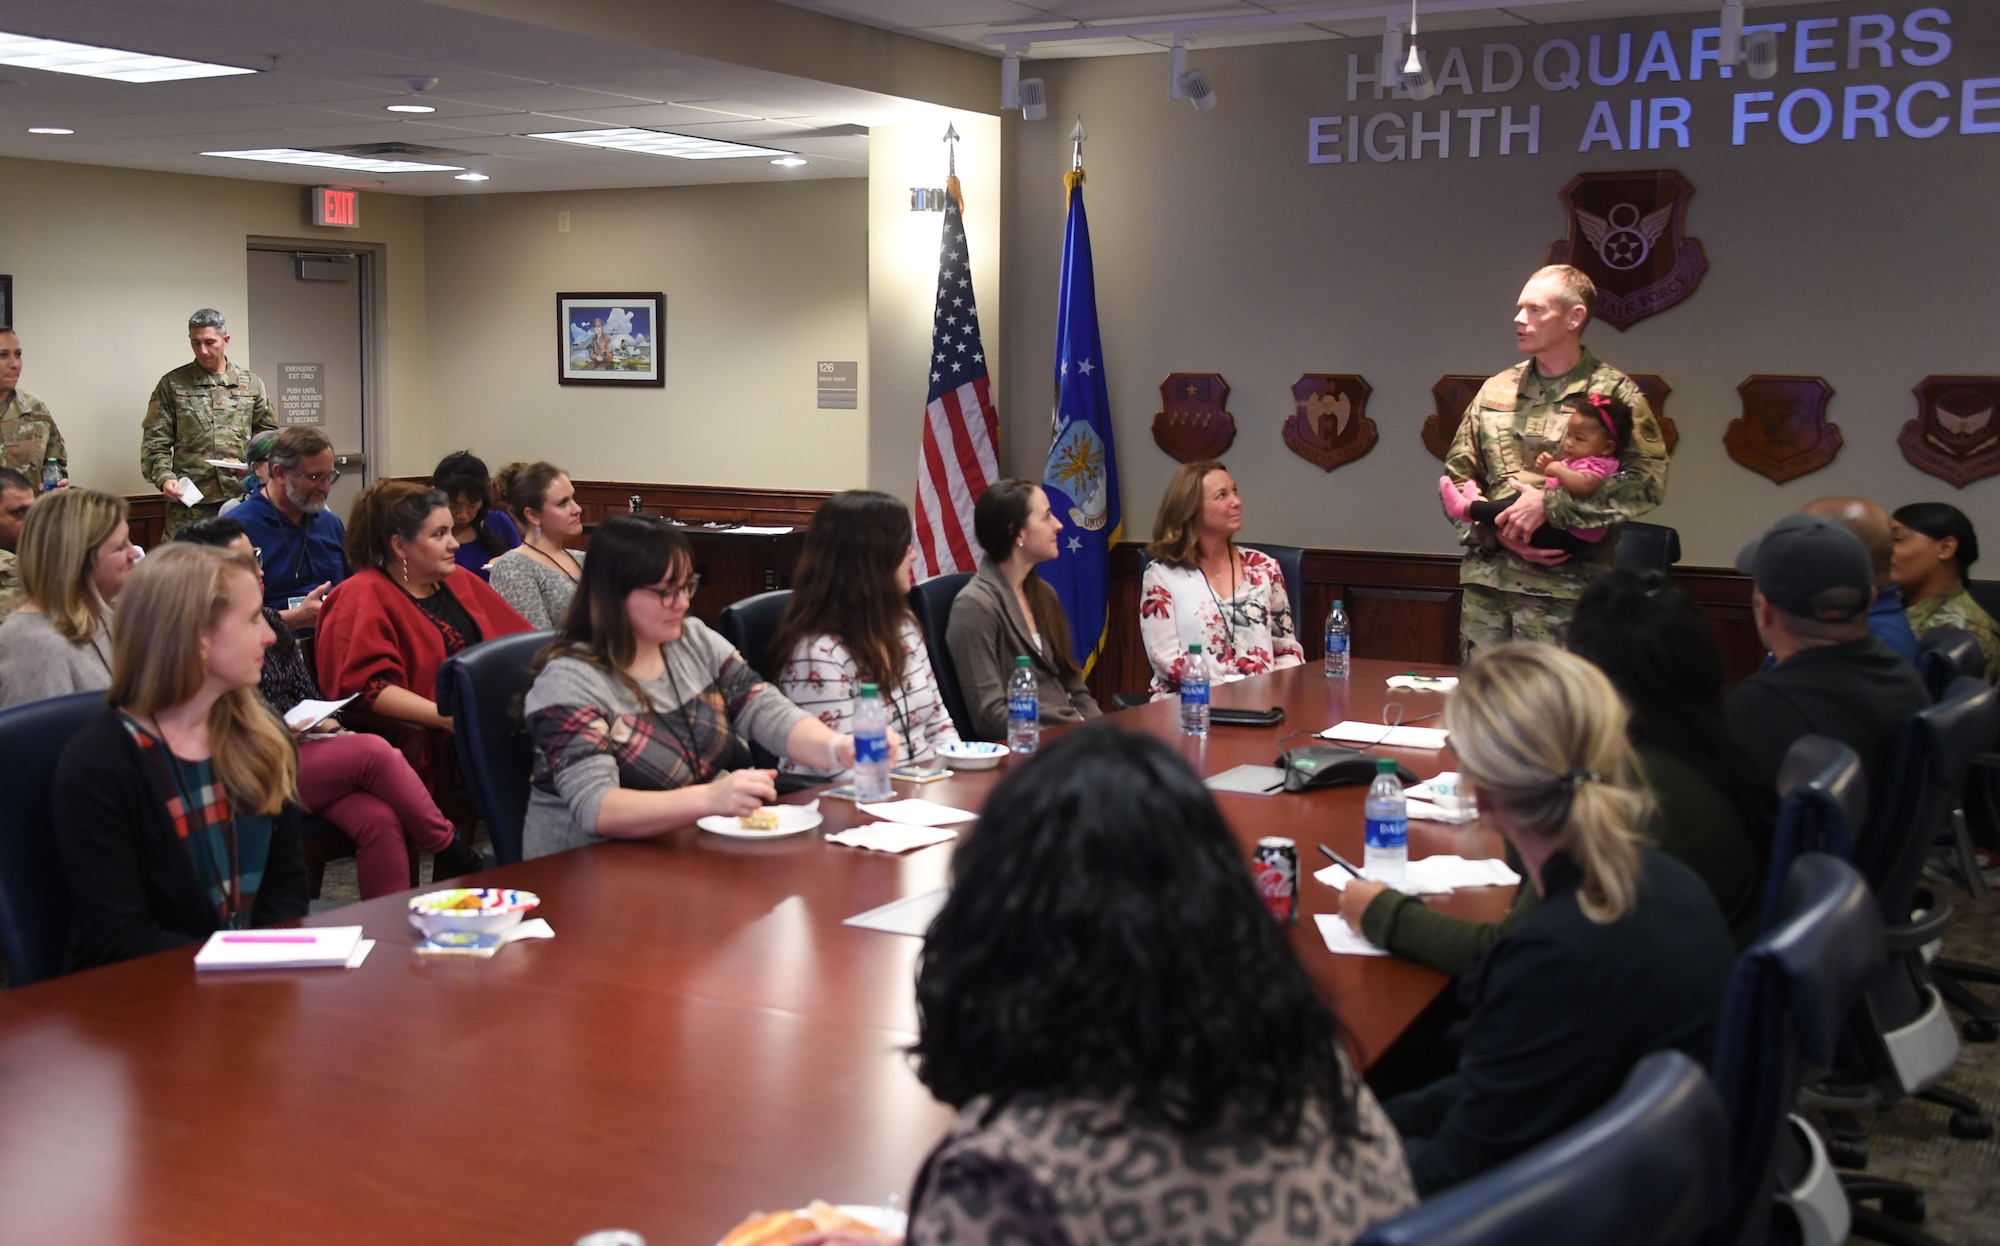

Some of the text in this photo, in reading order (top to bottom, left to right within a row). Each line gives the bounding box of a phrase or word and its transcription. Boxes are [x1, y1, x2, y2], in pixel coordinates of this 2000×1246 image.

[1307, 77, 2000, 164] EIGHTH AIR FORCE
[325, 190, 355, 225] EXIT
[819, 363, 834, 373] 126
